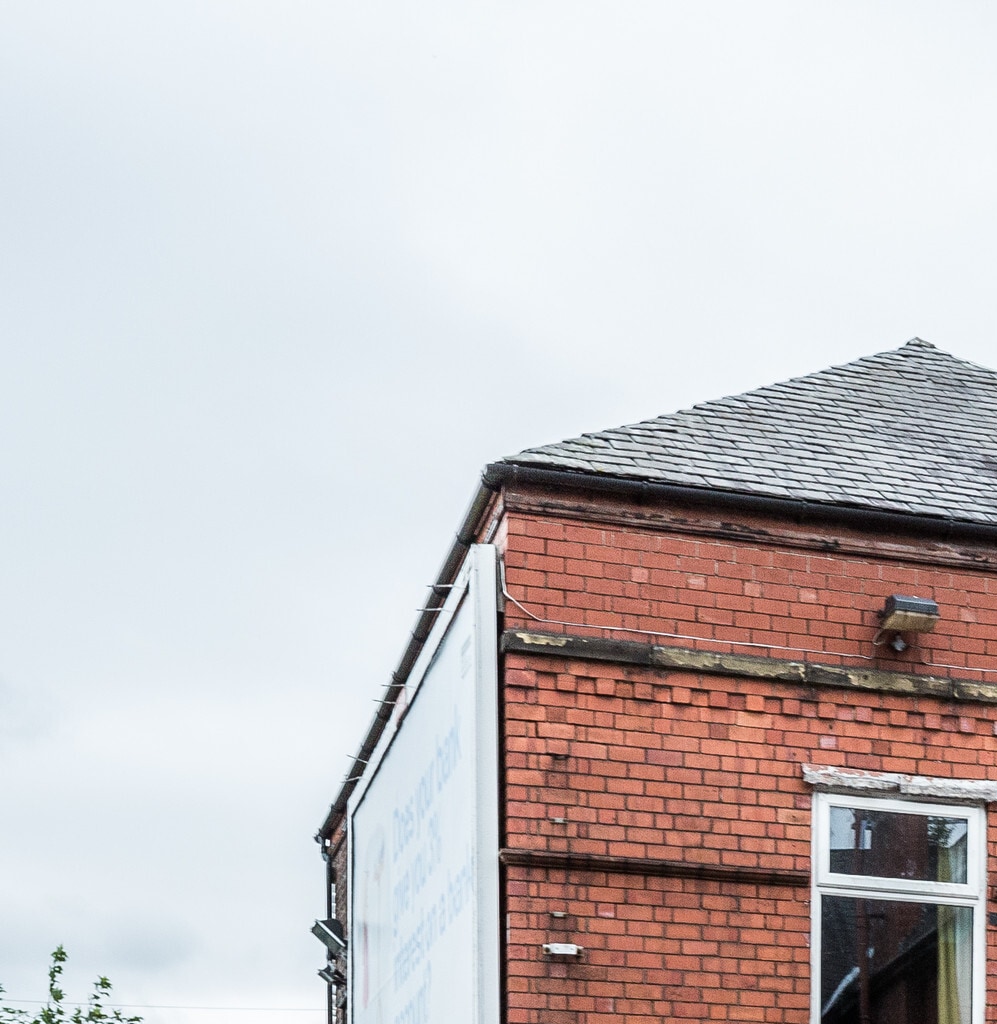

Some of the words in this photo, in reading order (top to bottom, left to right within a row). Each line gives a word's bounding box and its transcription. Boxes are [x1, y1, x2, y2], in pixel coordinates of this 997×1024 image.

[393, 796, 414, 863] Does
[414, 759, 434, 840] your
[436, 704, 462, 793] bank
